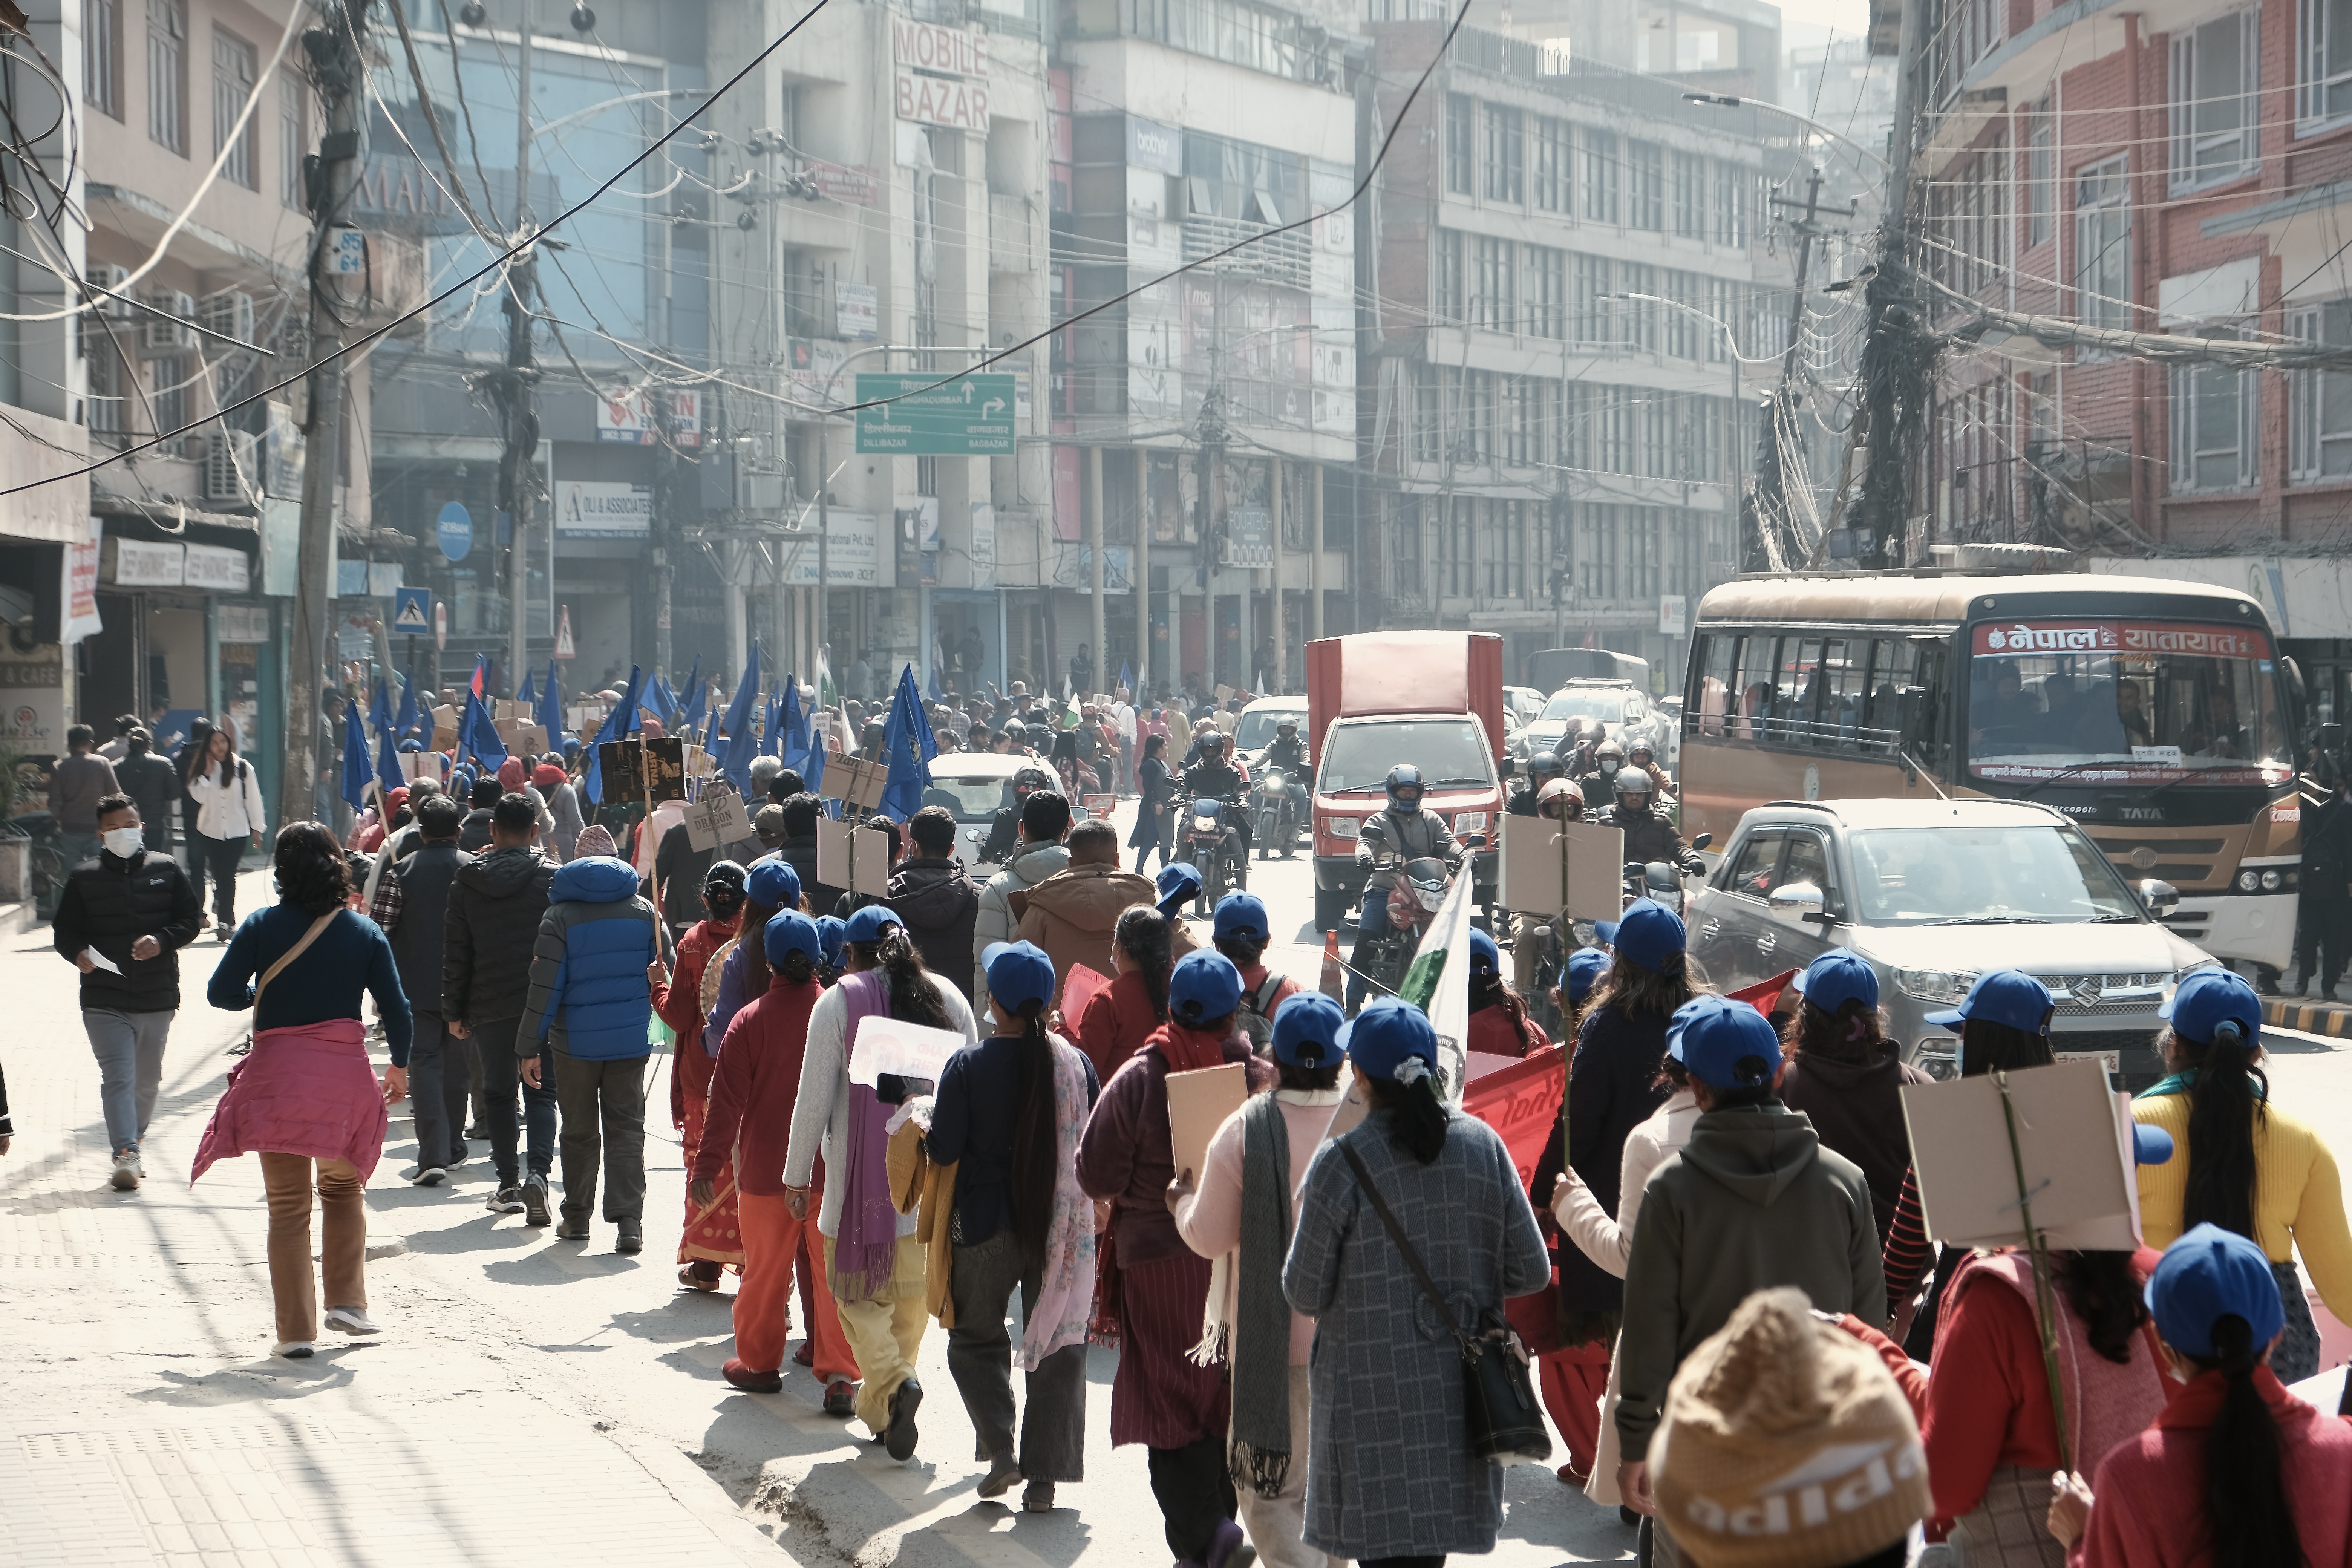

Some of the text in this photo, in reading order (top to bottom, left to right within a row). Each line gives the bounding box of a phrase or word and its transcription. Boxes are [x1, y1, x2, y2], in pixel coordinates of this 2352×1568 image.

[896, 23, 987, 75] MOBILE
[899, 77, 988, 129] BAZAR
[1137, 128, 1168, 155] brother
[341, 232, 362, 250] 85
[340, 254, 359, 272] 64
[1192, 289, 1210, 306] msi
[900, 395, 962, 404] SINGHADURBAR
[864, 439, 907, 447] DILLIBAZAR
[969, 440, 1008, 448] BAGBAZAR
[583, 496, 651, 514] OLI & ASSOCIATES
[1229, 511, 1272, 531] FOURTECH
[858, 569, 875, 581] acer
[2007, 625, 2237, 654] नेपाल यातायात
[20, 666, 56, 684] CAFE
[646, 750, 660, 787] ARNA
[2121, 807, 2162, 819] TATA
[702, 825, 720, 833] STROG
